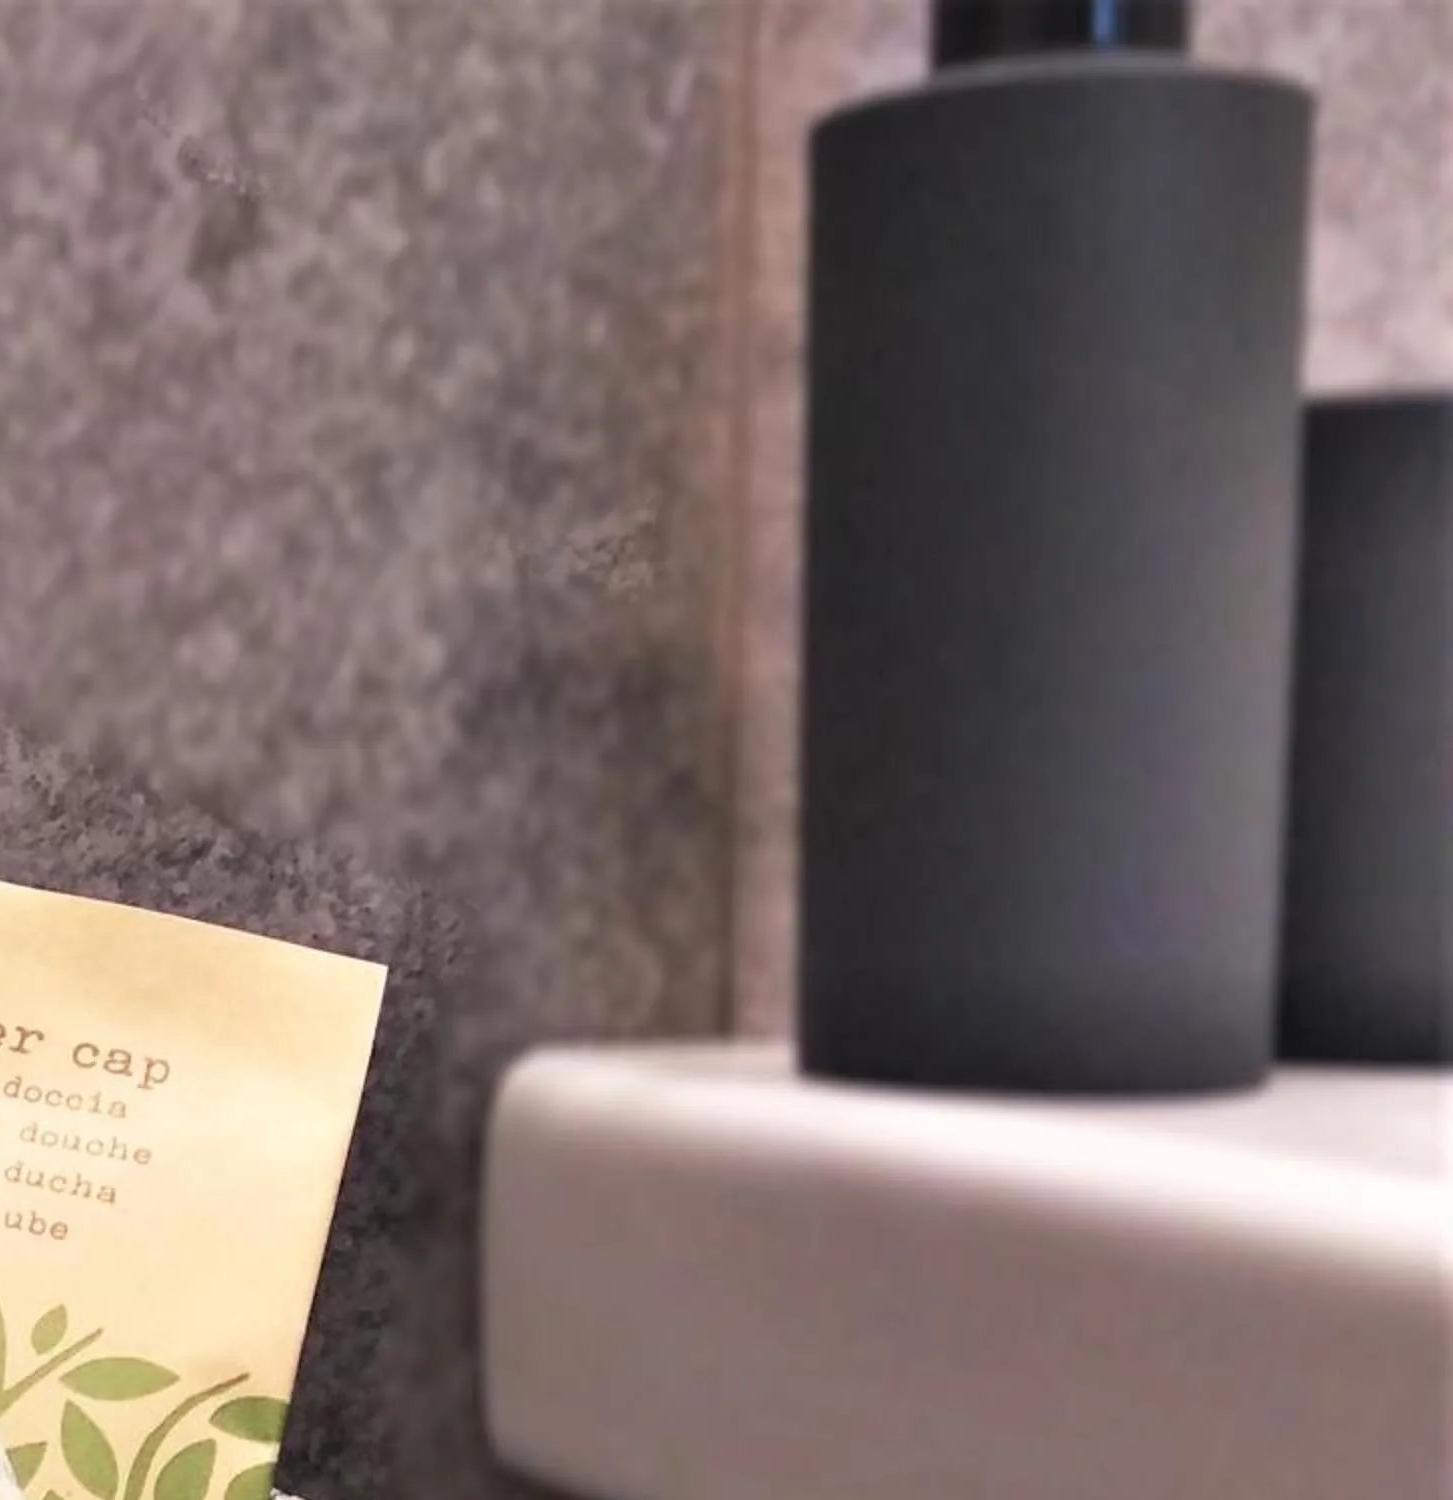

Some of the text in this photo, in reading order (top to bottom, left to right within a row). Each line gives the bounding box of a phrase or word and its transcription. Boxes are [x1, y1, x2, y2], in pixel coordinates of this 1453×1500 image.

[71, 1041, 171, 1090] cap
[3, 1075, 128, 1119] doccia
[19, 1121, 153, 1165] douche
[4, 1160, 117, 1204] ducha
